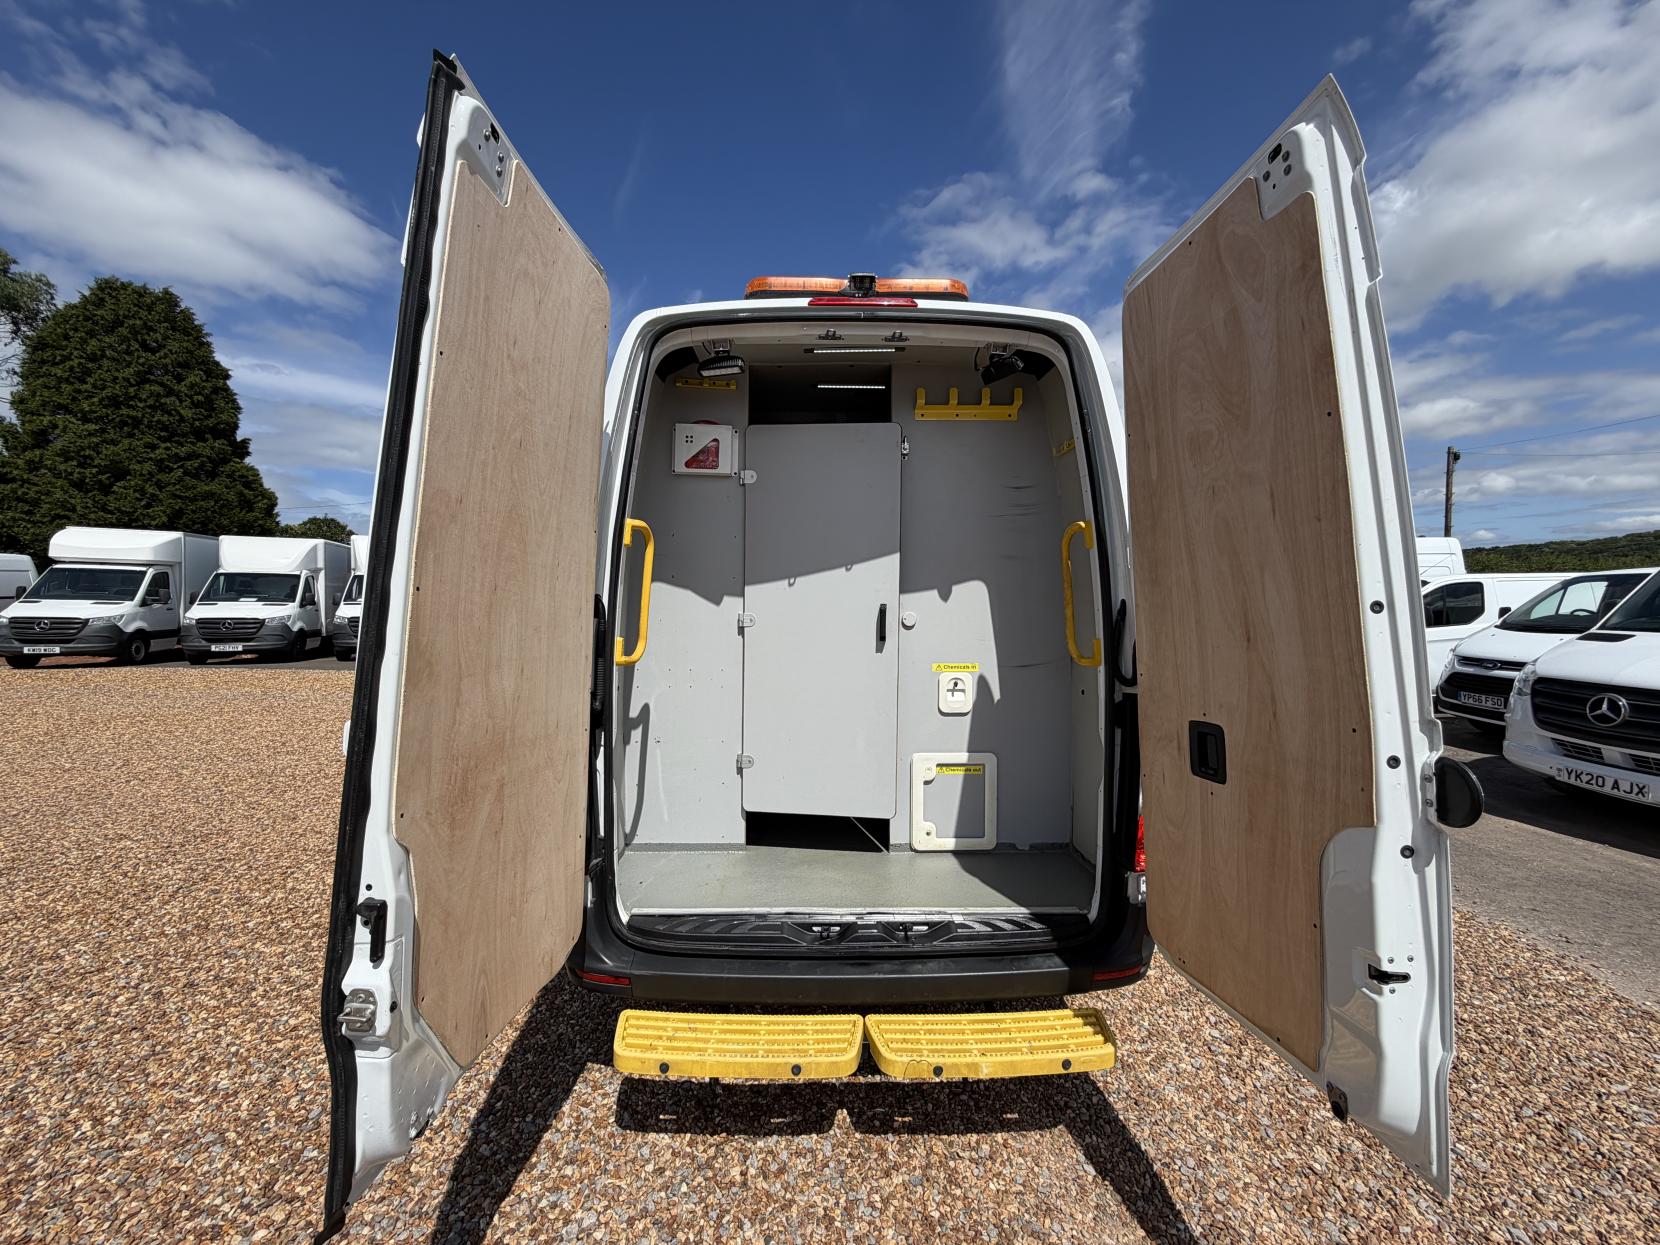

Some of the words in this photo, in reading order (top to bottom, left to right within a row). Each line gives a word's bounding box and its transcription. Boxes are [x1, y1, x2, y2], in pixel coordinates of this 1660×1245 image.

[1462, 691, 1483, 704] YP66
[1485, 696, 1503, 707] FSD
[1565, 767, 1606, 788] YK20
[1611, 779, 1647, 798] AJX
